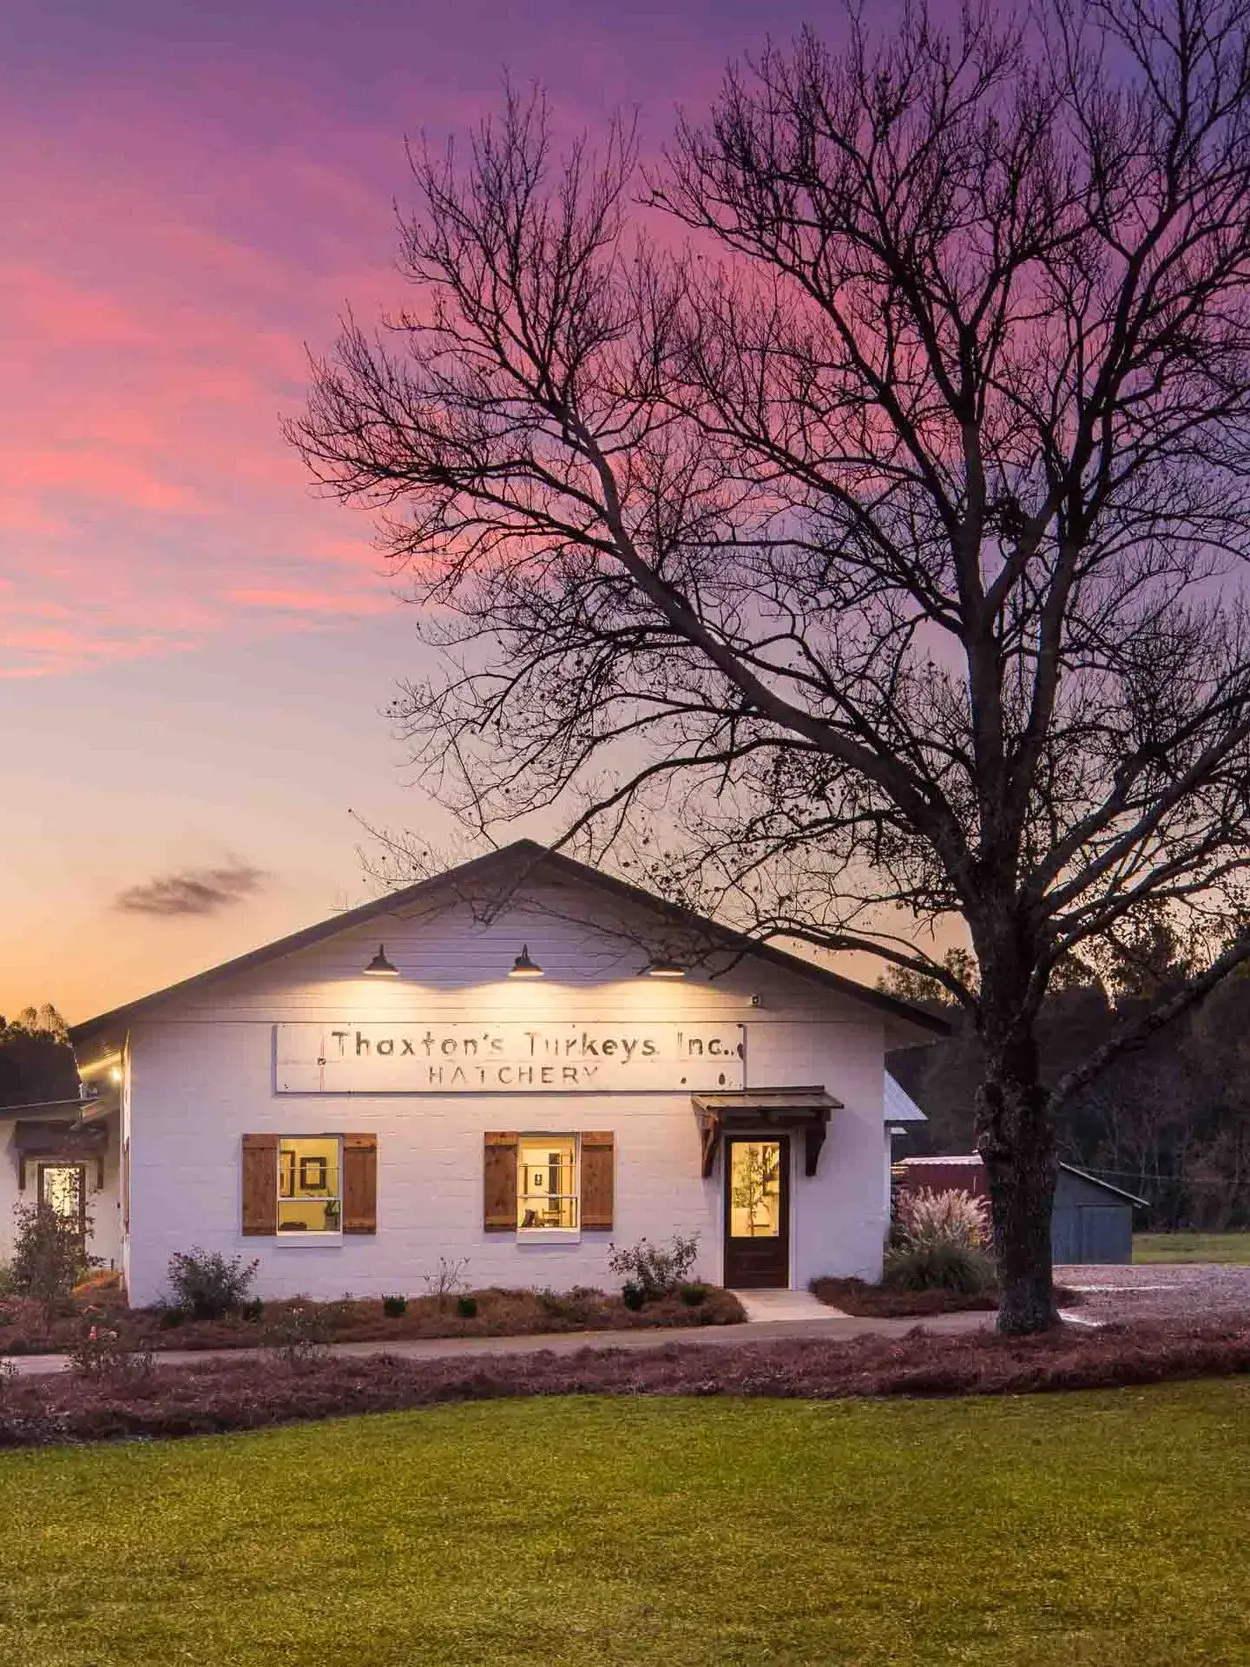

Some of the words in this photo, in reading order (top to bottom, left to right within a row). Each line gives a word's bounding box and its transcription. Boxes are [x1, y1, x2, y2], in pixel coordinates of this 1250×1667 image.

[331, 1031, 504, 1057] Thaxton's
[524, 1031, 656, 1065] Turkeys
[429, 1066, 599, 1084] HATCHERY
